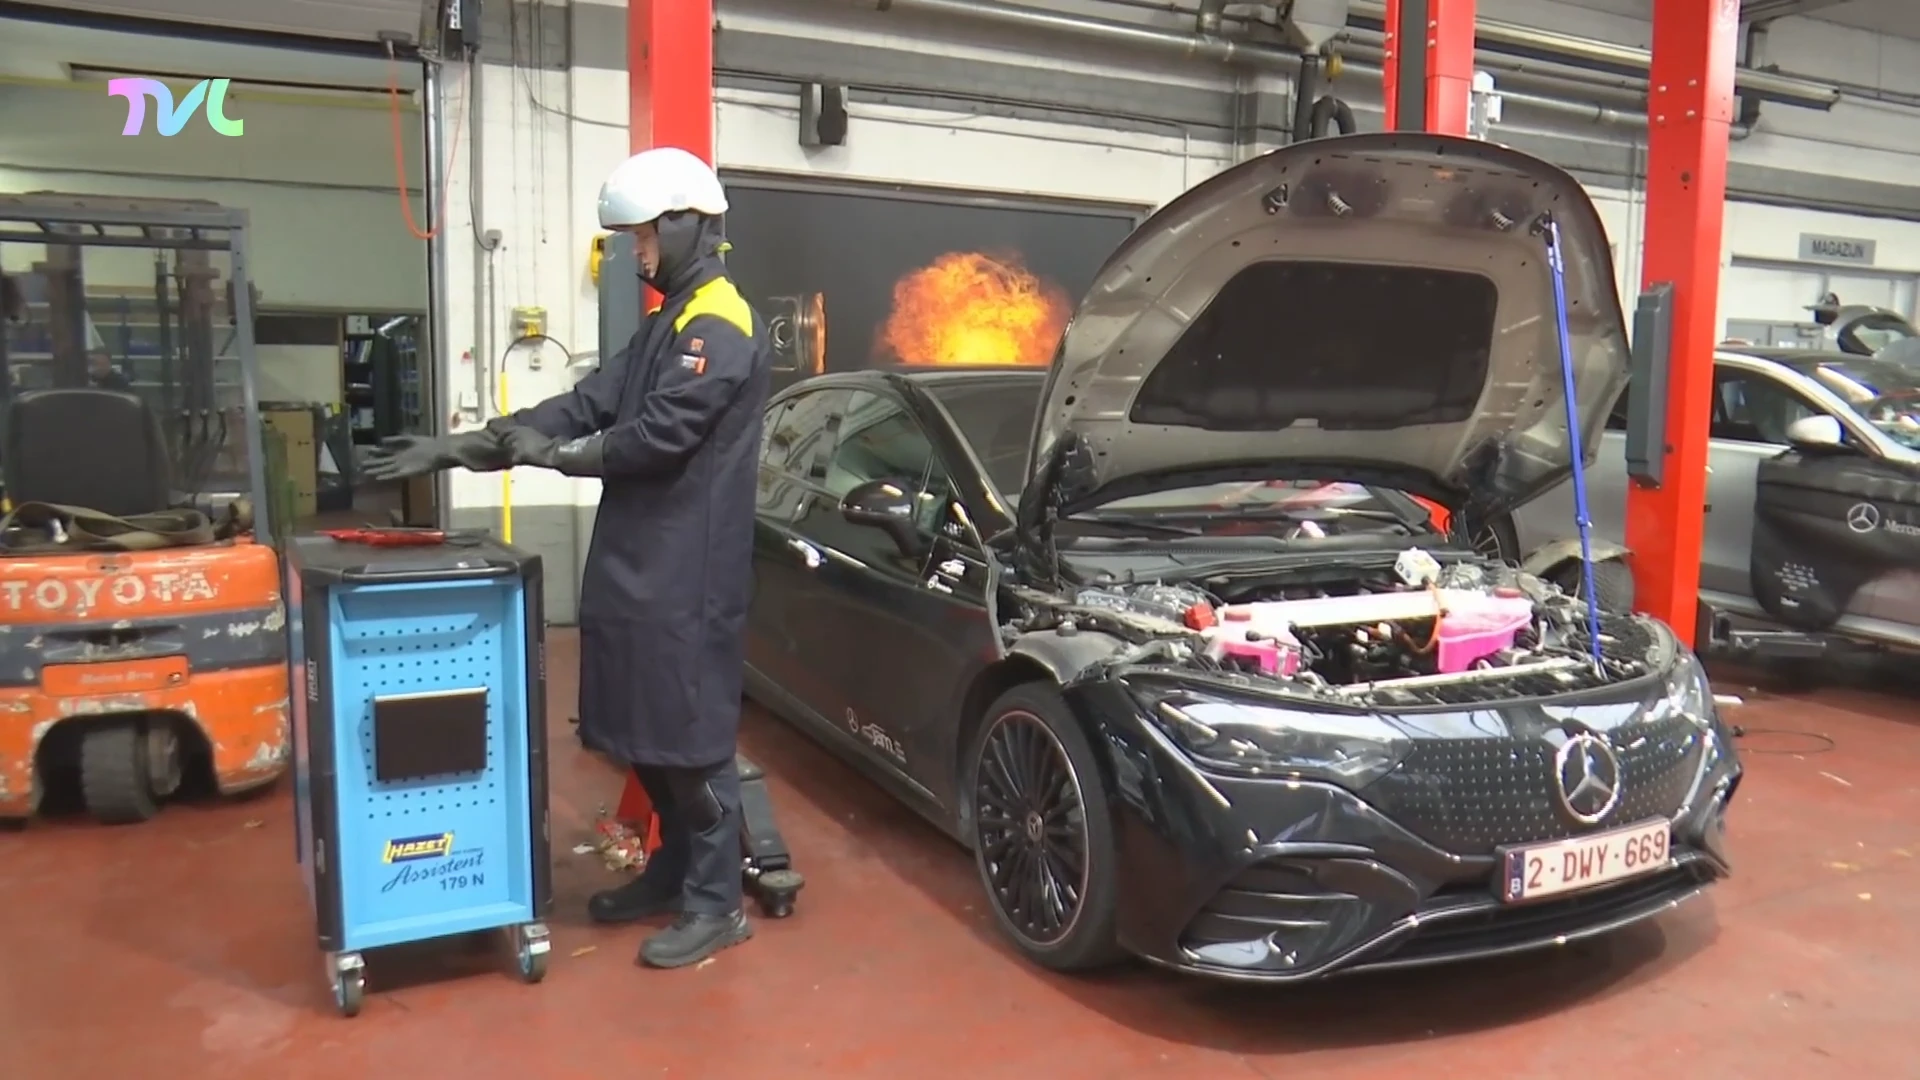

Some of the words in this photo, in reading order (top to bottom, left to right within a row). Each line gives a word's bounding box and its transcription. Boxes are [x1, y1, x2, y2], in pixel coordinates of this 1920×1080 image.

[2, 571, 216, 611] TOYOTA
[388, 838, 449, 860] HAZET
[381, 852, 484, 893] Assistent
[440, 875, 468, 891] 179
[472, 872, 485, 886] N
[1510, 877, 1521, 893] B
